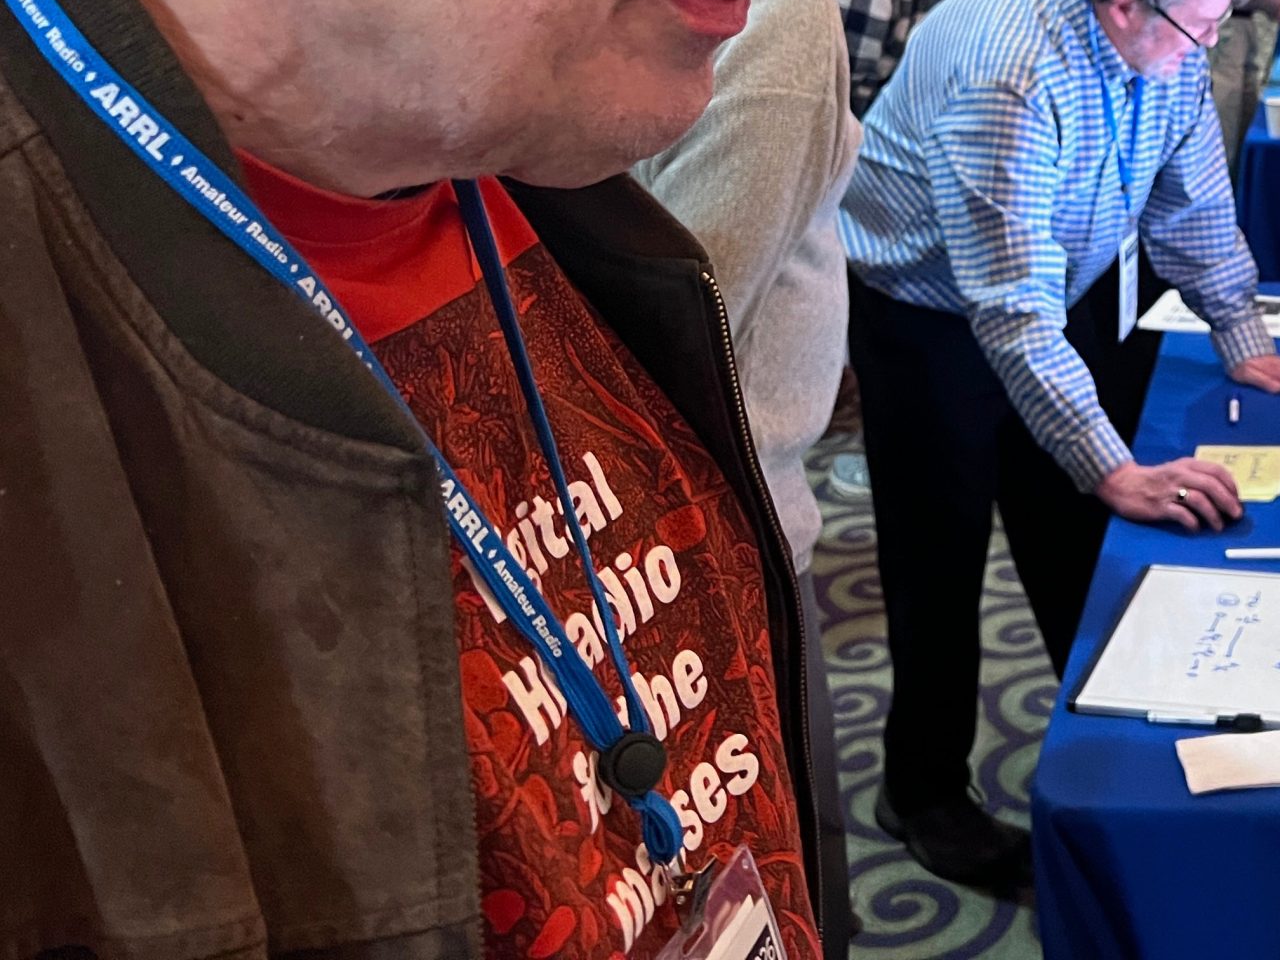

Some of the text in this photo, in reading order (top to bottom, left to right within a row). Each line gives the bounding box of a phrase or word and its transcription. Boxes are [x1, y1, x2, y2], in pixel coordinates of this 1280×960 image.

[45, 25, 85, 73] Radio
[90, 82, 175, 162] ARRL
[180, 165, 248, 227] Amateur
[246, 222, 289, 265] Radio
[493, 559, 536, 618] Amateur
[531, 613, 563, 659] Radio
[565, 545, 682, 670] adio
[617, 649, 708, 741] he
